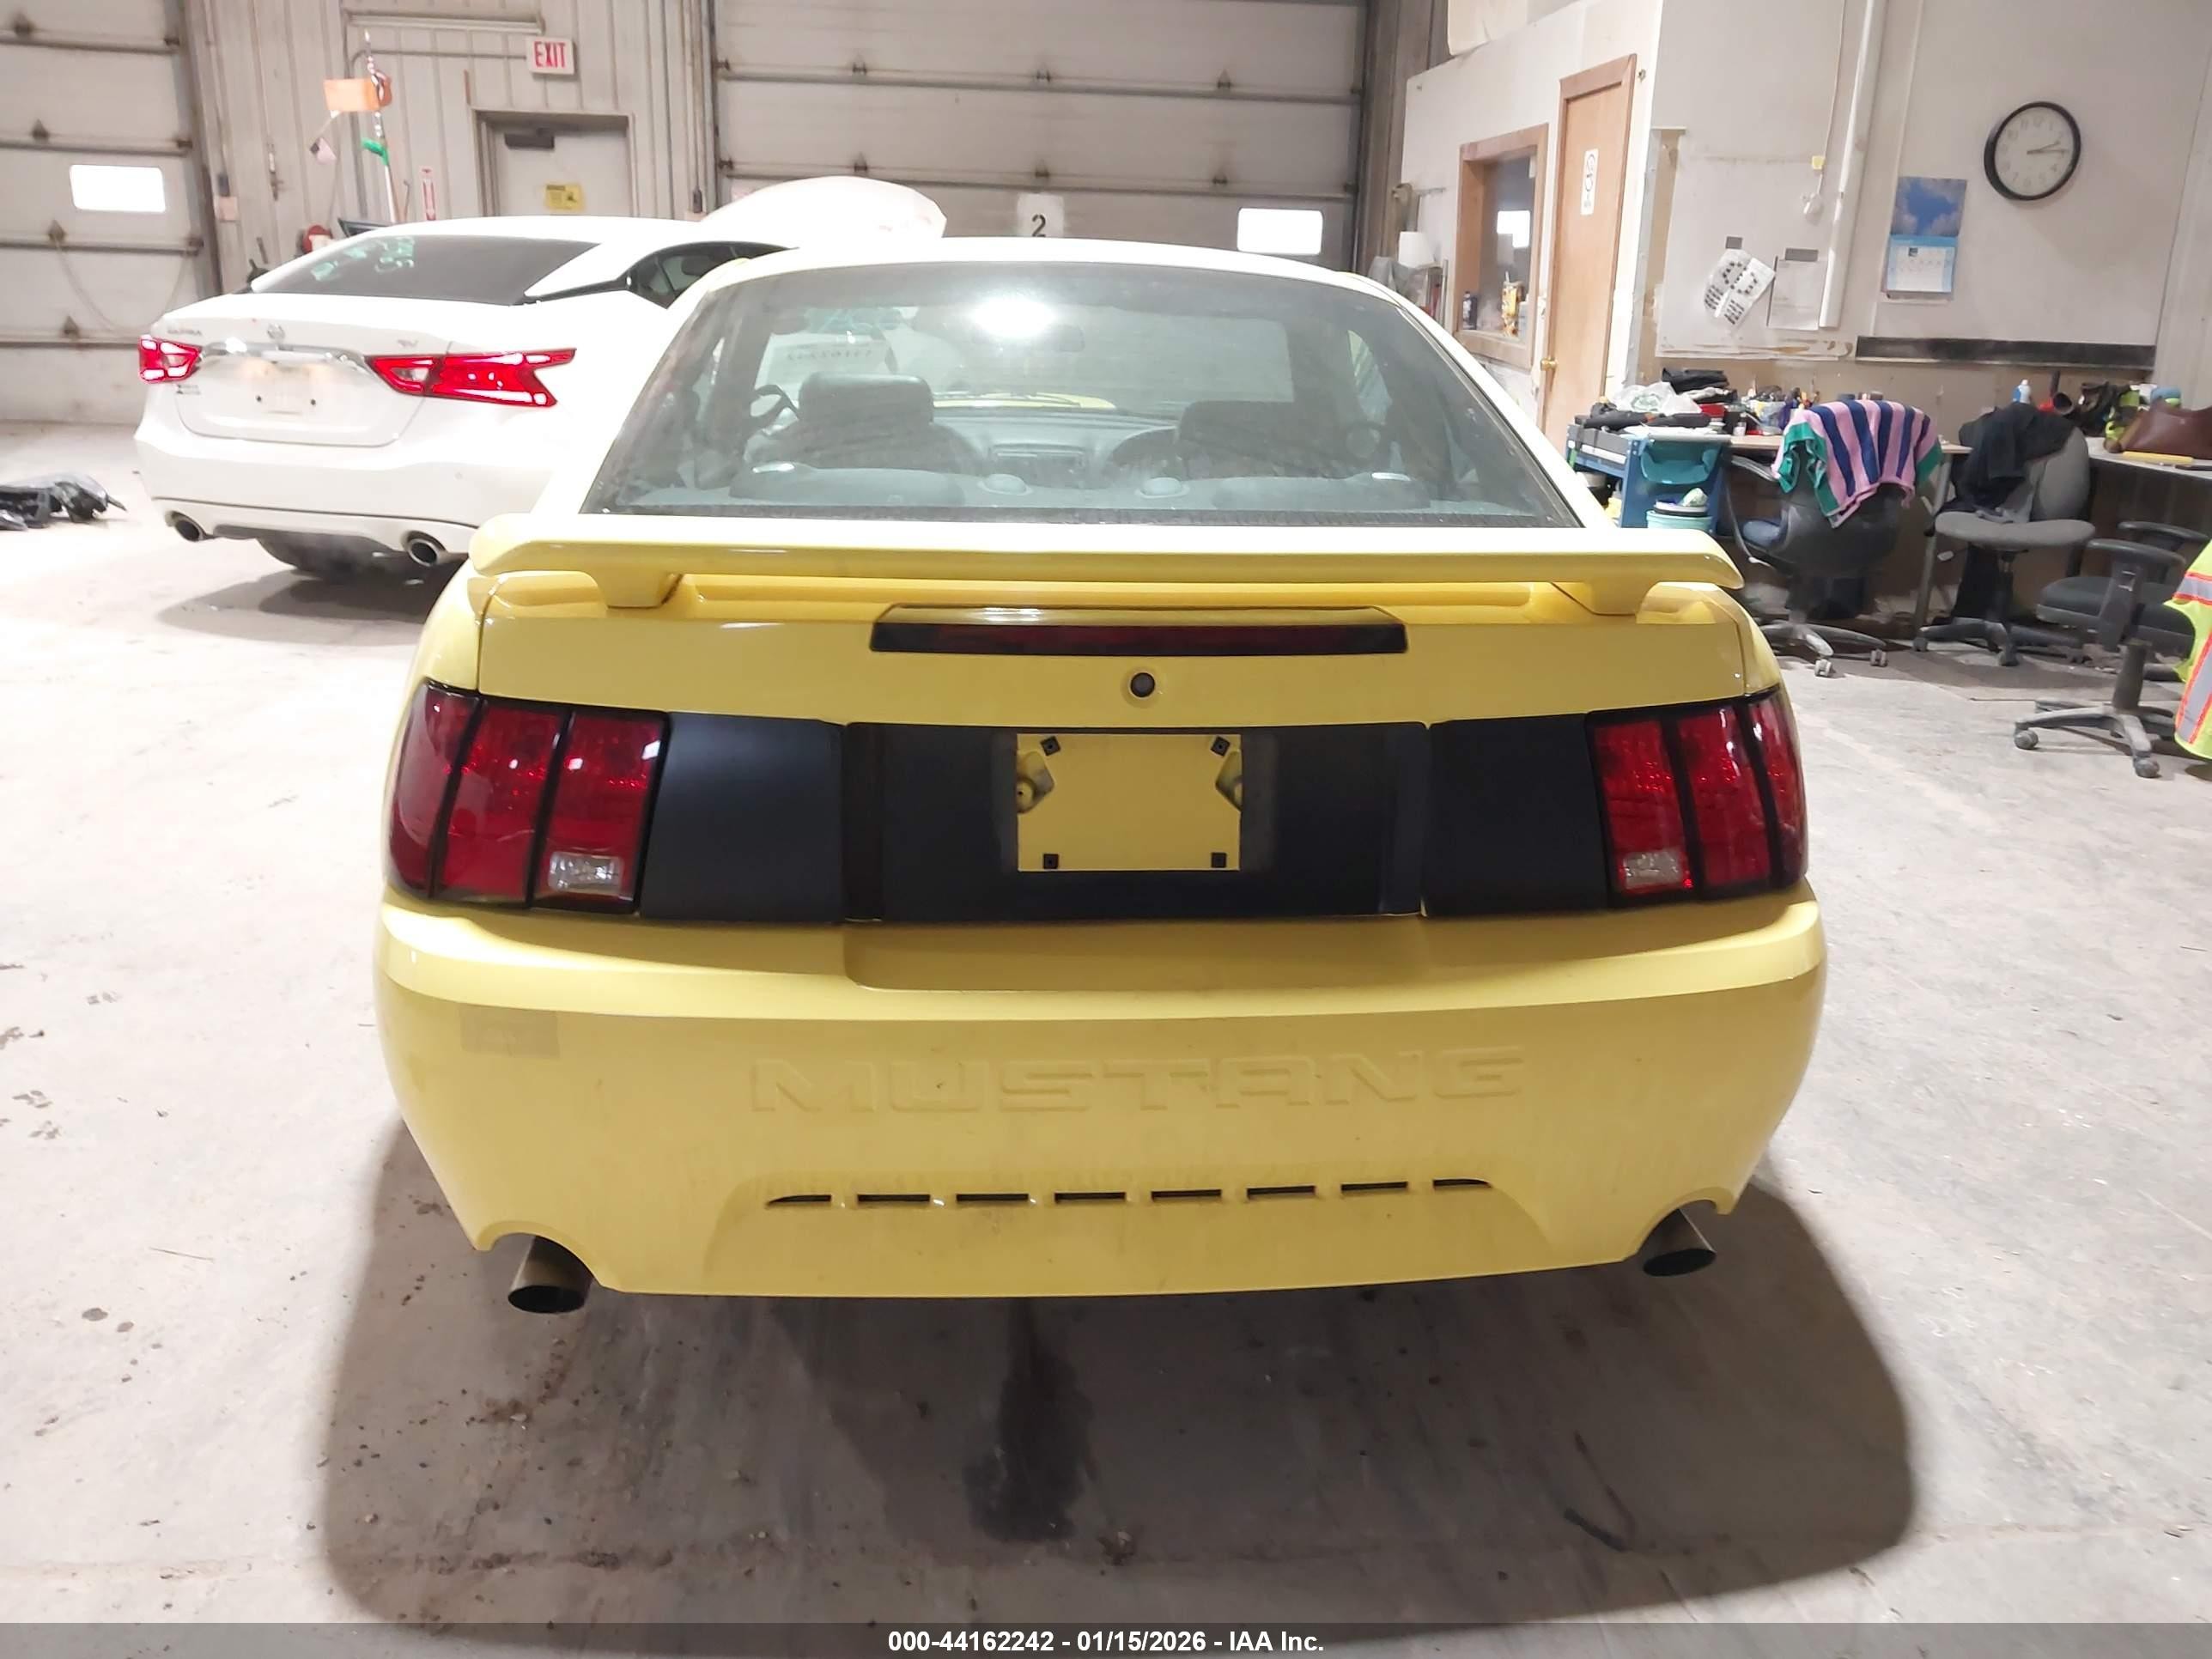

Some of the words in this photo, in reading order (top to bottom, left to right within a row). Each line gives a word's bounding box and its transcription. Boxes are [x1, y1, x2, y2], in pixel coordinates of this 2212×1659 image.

[533, 41, 566, 69] EXIT
[1031, 213, 1047, 238] 2
[751, 1044, 1526, 1113] MUSTANG
